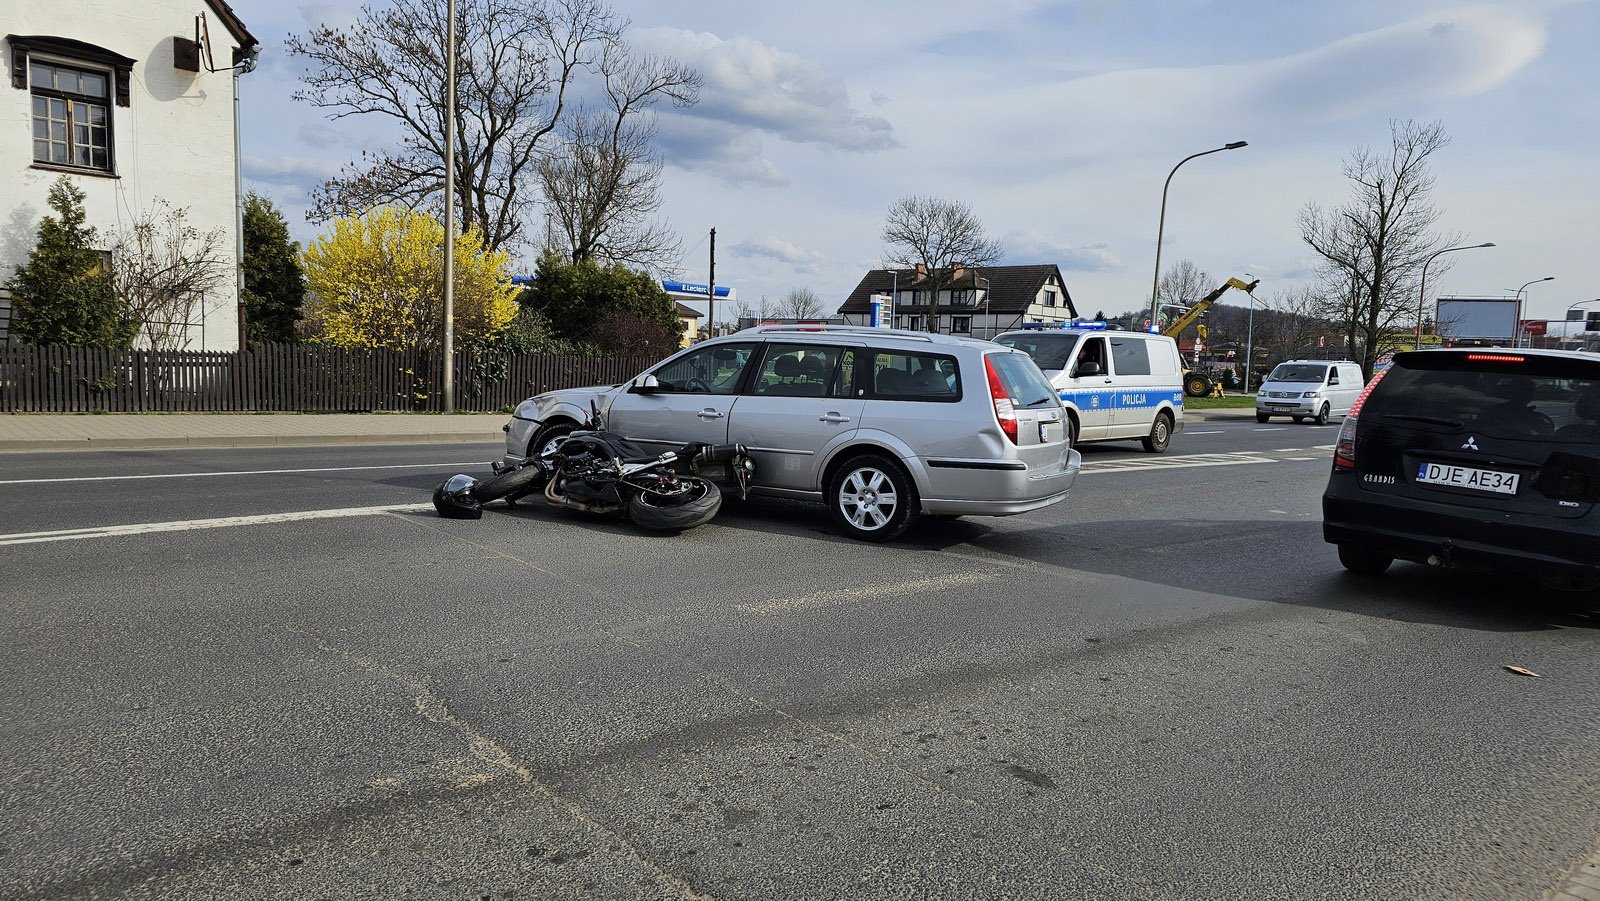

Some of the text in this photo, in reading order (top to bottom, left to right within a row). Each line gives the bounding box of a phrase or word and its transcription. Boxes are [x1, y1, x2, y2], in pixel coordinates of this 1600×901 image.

[1122, 393, 1146, 405] POLICJA
[1363, 473, 1395, 485] GRANDIS
[1429, 465, 1464, 483] DJE
[1468, 470, 1515, 490] AE34
